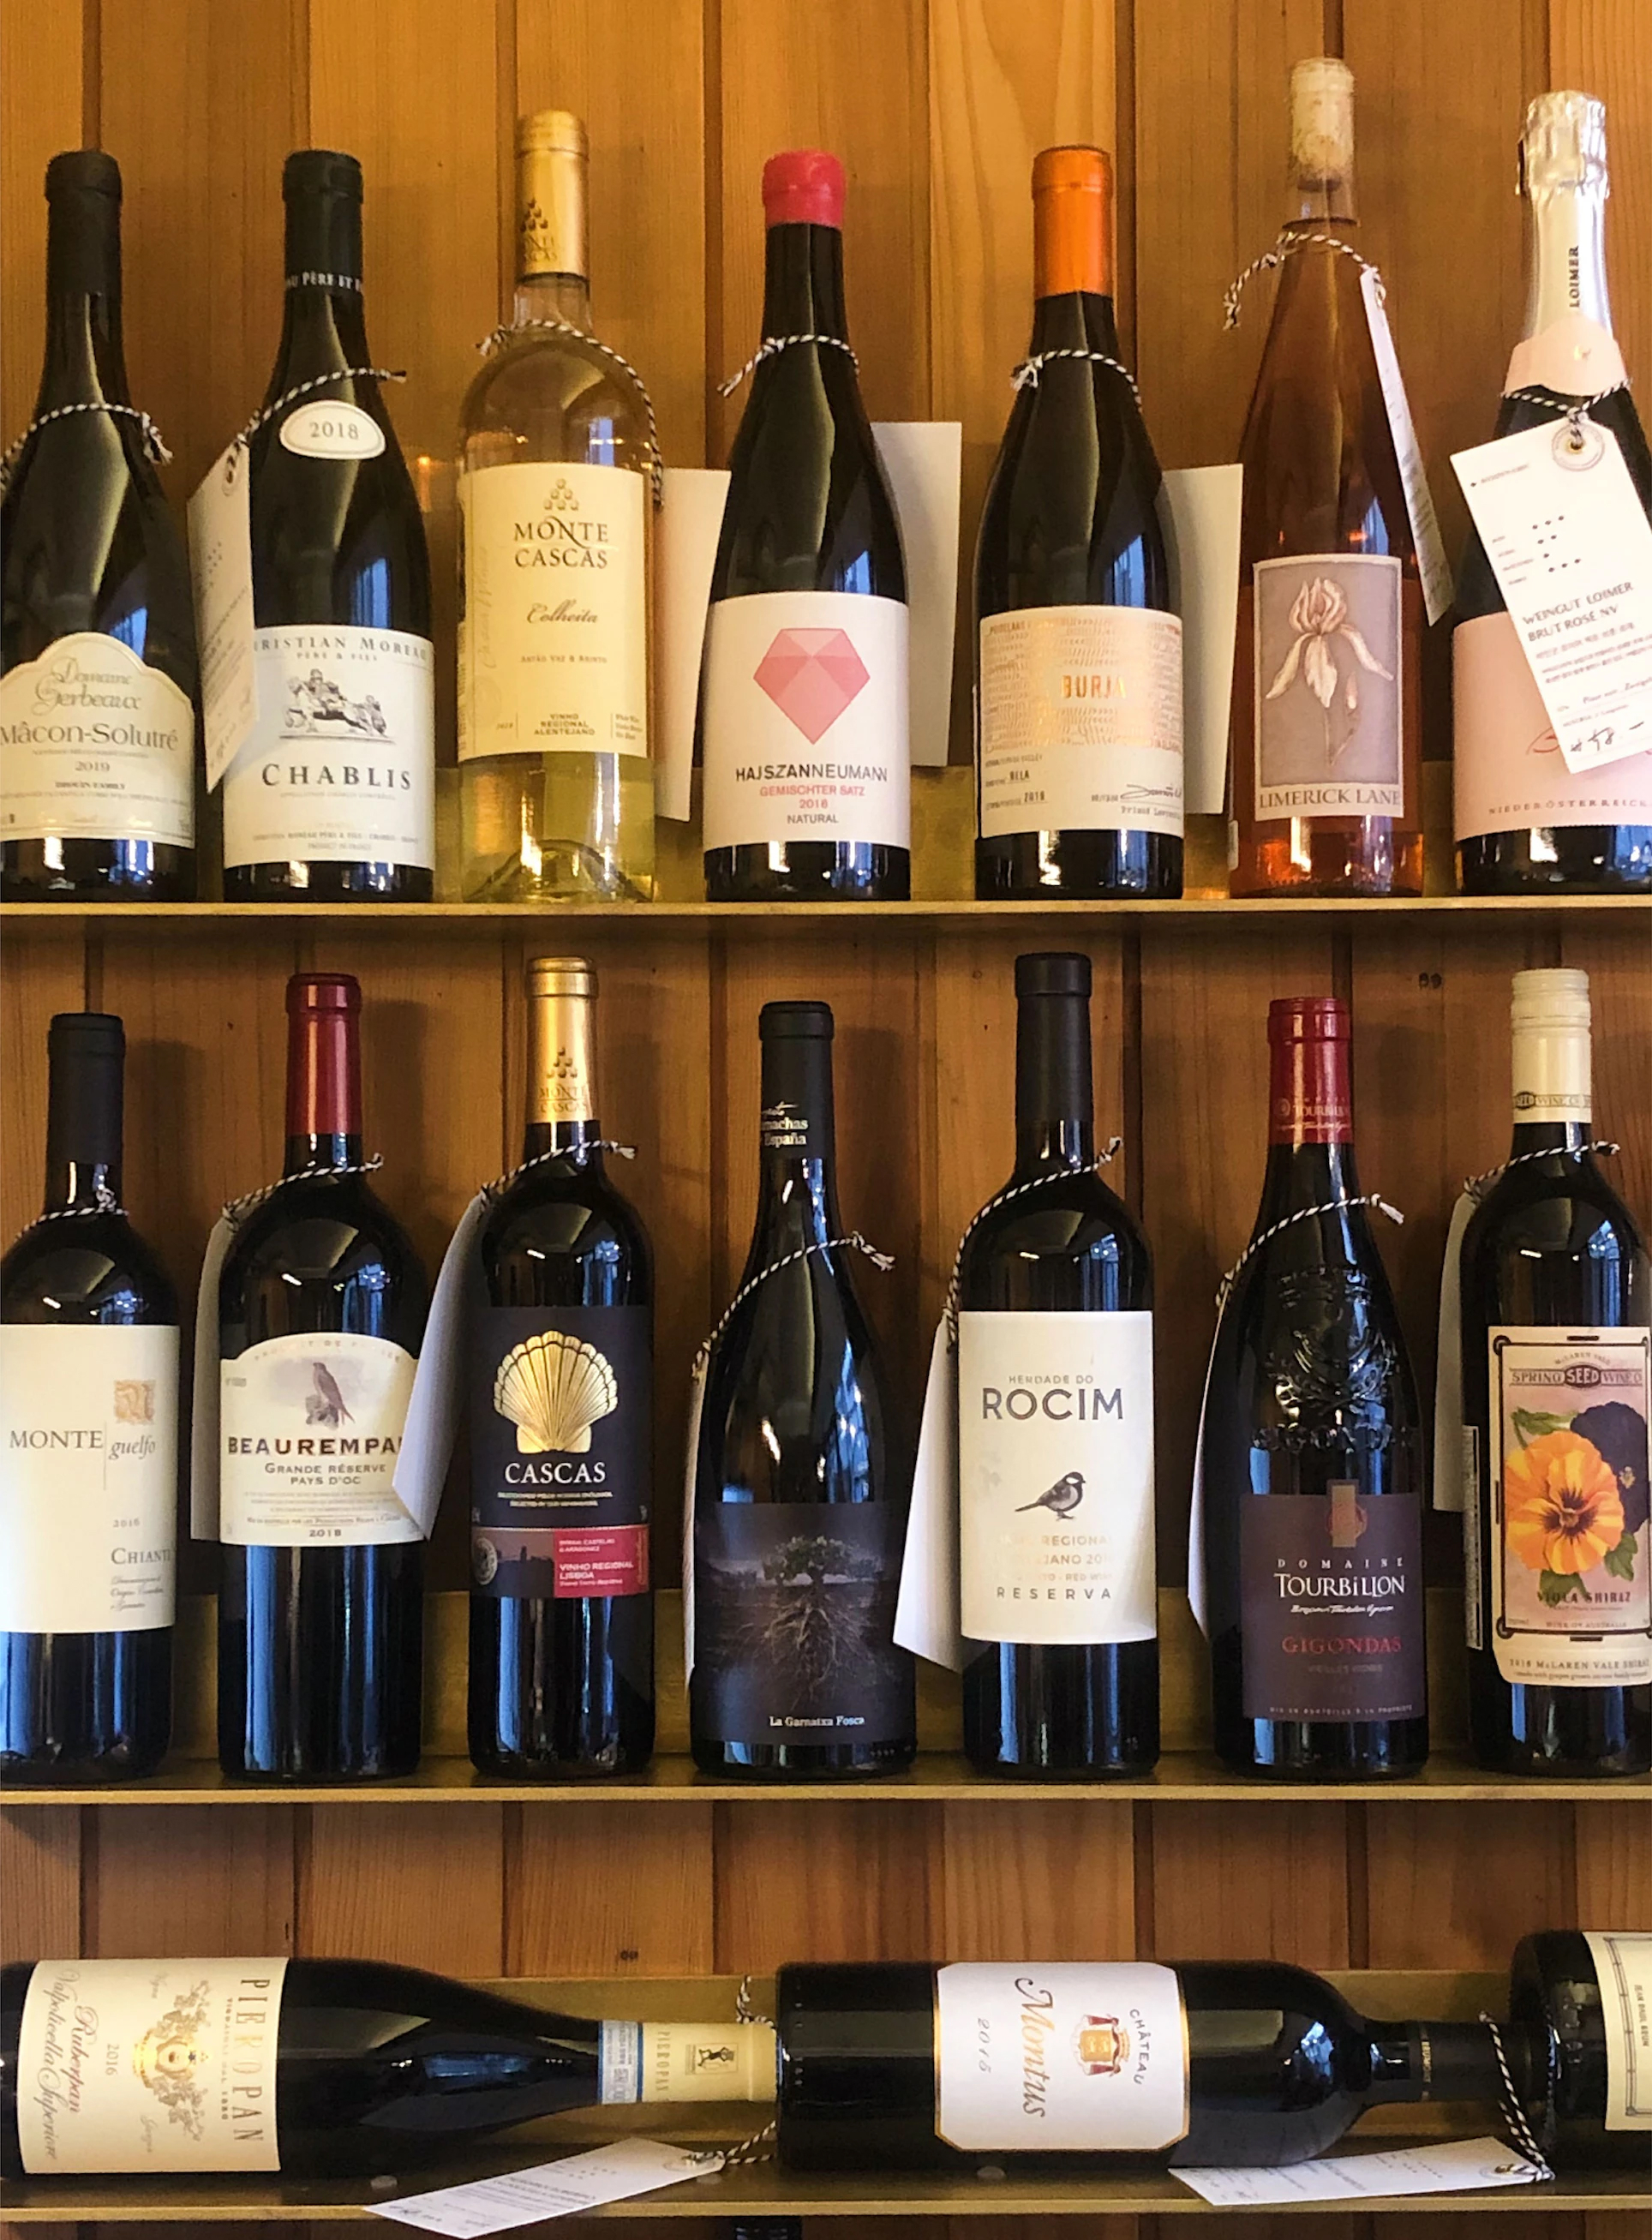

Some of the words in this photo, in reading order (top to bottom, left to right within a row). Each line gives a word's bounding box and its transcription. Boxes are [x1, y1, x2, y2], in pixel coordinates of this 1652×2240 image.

[1568, 245, 1579, 308] LOIMER
[309, 422, 358, 440] 2018
[514, 519, 608, 542] MONTE
[514, 548, 608, 569] CASCAS
[526, 599, 598, 624] Colheita
[1523, 598, 1581, 625] WEINGUT
[1586, 582, 1634, 605] LOIMER
[1528, 622, 1562, 642] BRUT
[1600, 603, 1619, 616] NV
[51, 656, 132, 684] Domaine
[32, 677, 142, 716] Gerbeaux
[1062, 675, 1127, 699] BURJA
[0, 722, 178, 750] Mâcon-Solutré
[75, 761, 111, 772] 2019
[262, 764, 411, 790] CHABLIS
[736, 764, 888, 782] HAJSZANNEUMANN
[759, 785, 836, 797] GEMISCHTER
[840, 786, 865, 797] SATZ
[1260, 788, 1351, 808] LIMERICK
[1356, 788, 1400, 806] LANE
[787, 814, 839, 824] NATURAL
[1009, 1375, 1069, 1385] HERDADE
[1076, 1375, 1094, 1385] DO
[1566, 1368, 1600, 1384] SEED
[982, 1387, 1124, 1421] ROCIM
[9, 1430, 103, 1449] MONTE
[108, 1434, 157, 1460] guelfo
[228, 1437, 402, 1456] BEAUREMPA
[265, 1463, 322, 1474] GRANDE
[328, 1463, 386, 1474] RÉSERVE
[505, 1462, 606, 1483] CASCAS
[290, 1476, 324, 1485] PAYS
[329, 1476, 361, 1485] D'OC
[309, 1529, 342, 1537] 2018
[1041, 1535, 1110, 1547] REGIONA
[560, 1562, 591, 1572] VINHO
[592, 1561, 634, 1570] REGIONAL
[1278, 1557, 1404, 1569] DOMAINE
[997, 1586, 1111, 1600] RESERVA
[1282, 1635, 1402, 1655] GIGONDAS
[1593, 1659, 1619, 1669] VALE
[769, 1716, 783, 1727] La
[785, 1716, 833, 1727] Garnatxa
[835, 1715, 865, 1726] Fosca
[41, 1968, 81, 2066] Valpolicella
[978, 2017, 991, 2073] 2015
[1015, 1978, 1055, 2118] Montus
[1129, 2009, 1152, 2085] CHÂTEAU
[61, 2005, 99, 2114] Ruberpan
[105, 2043, 120, 2076] 2016
[232, 1979, 271, 2141] PIEROPAN
[655, 2030, 671, 2092] PIEROPAN
[33, 2067, 69, 2159] Superiore
